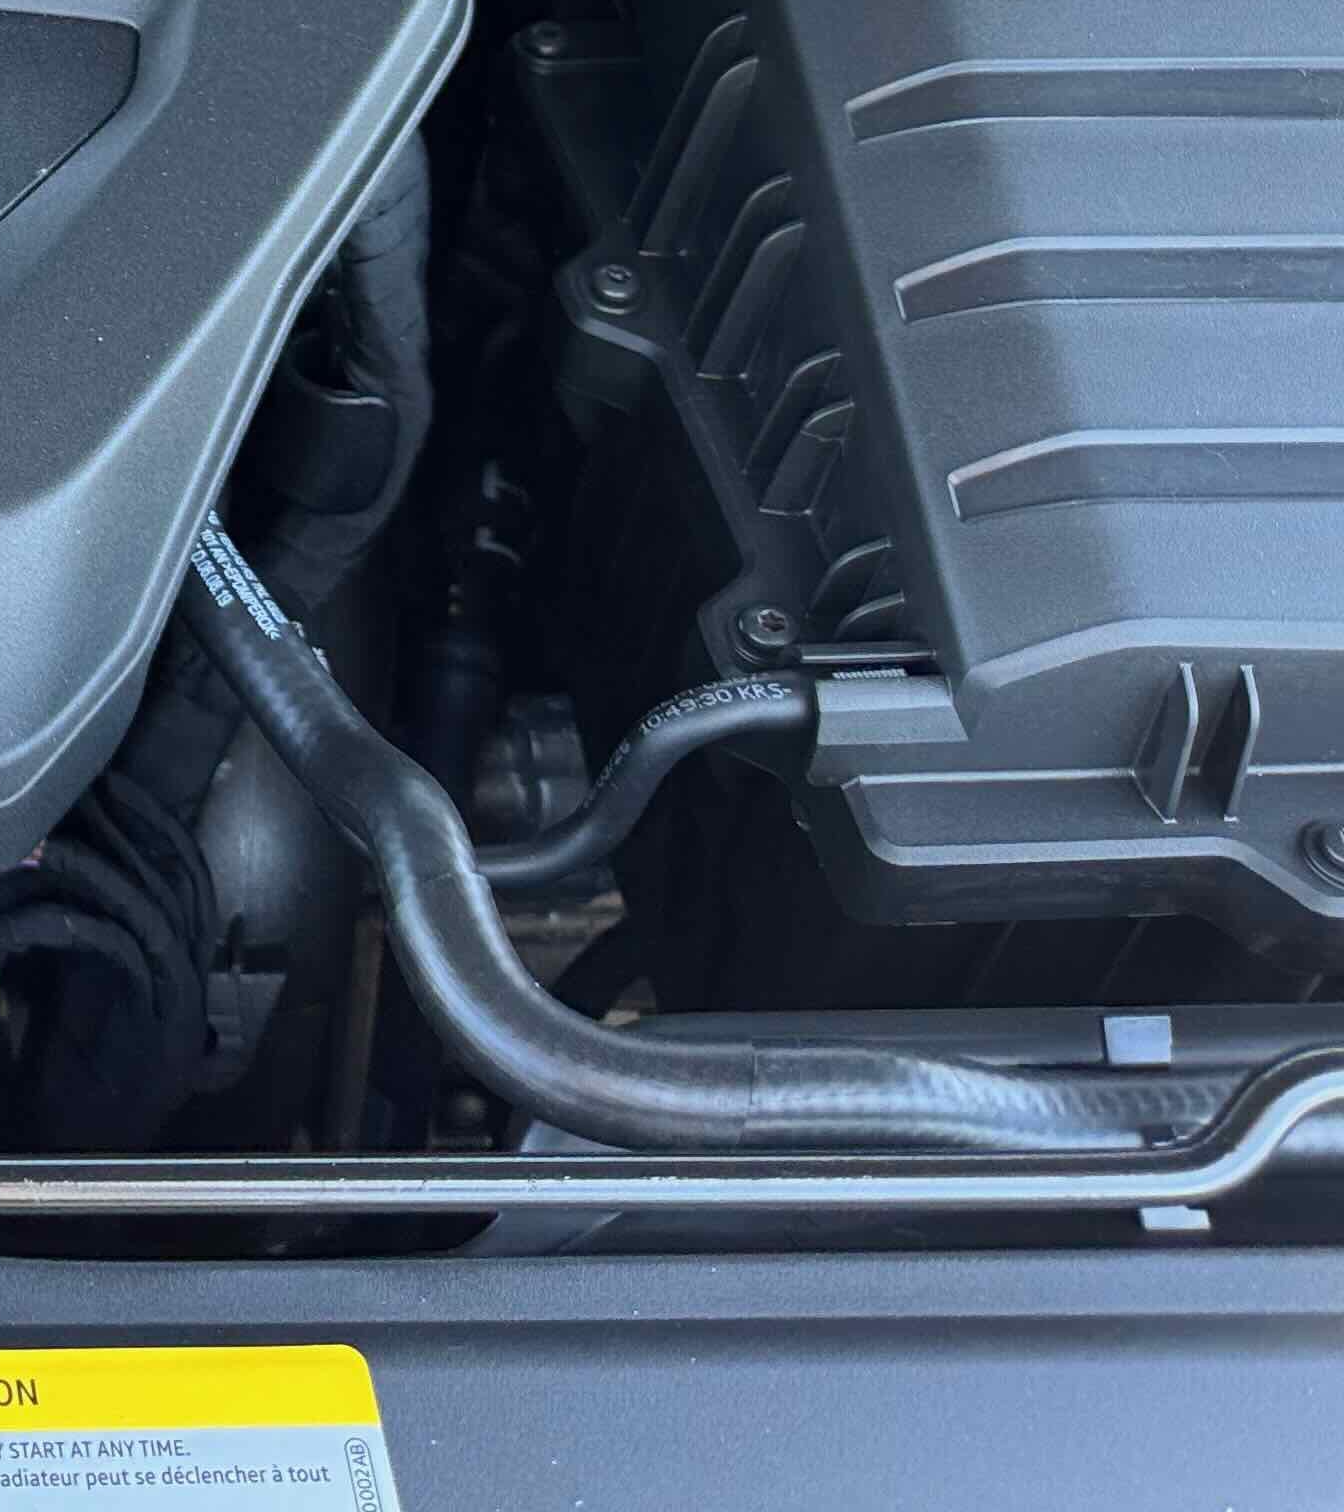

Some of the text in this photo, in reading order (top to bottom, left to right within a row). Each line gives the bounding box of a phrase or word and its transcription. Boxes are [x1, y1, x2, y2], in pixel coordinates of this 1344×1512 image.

[8, 1441, 65, 1460] START
[71, 1441, 92, 1458] AT
[97, 1439, 134, 1458] ANY
[137, 1439, 192, 1458] TIME.
[86, 1469, 130, 1490] peut
[135, 1470, 157, 1486] se
[161, 1465, 266, 1485] déclencher
[273, 1464, 284, 1483] à
[287, 1465, 330, 1484] tout
